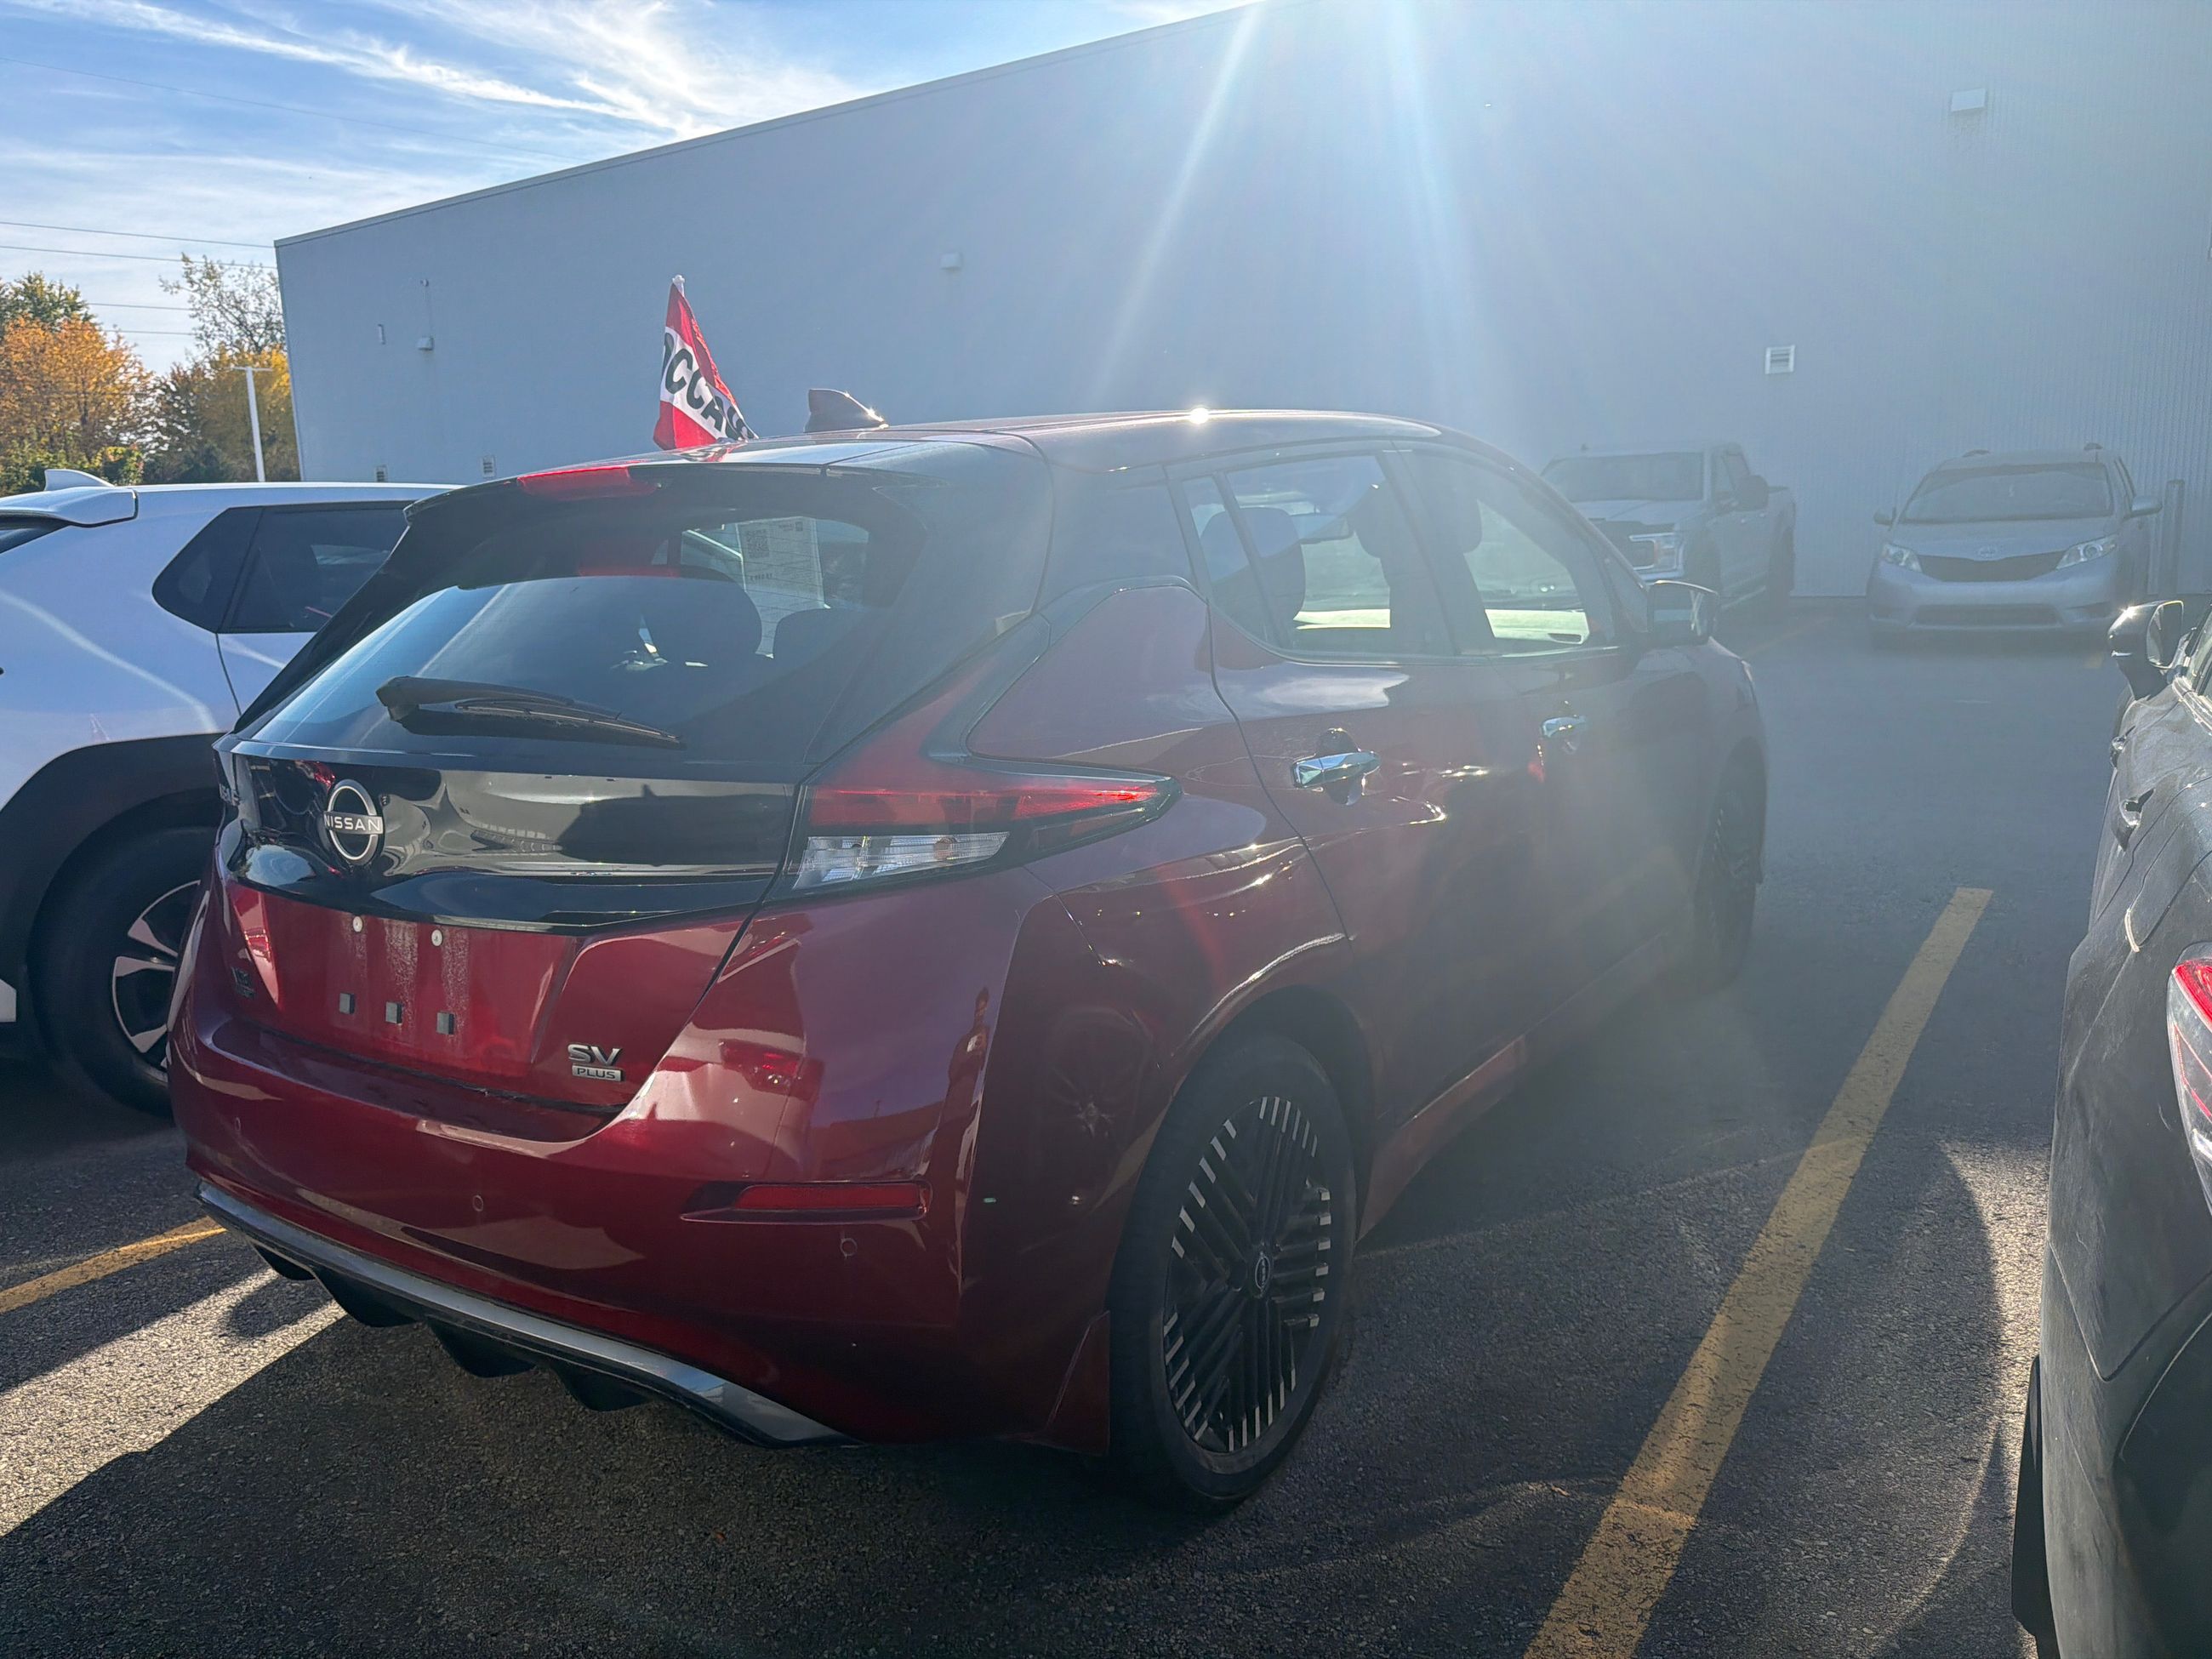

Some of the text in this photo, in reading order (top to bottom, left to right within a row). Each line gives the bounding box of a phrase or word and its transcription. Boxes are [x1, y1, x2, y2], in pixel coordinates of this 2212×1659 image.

[323, 813, 380, 831] NISSAN
[567, 1043, 621, 1067] SV
[577, 1067, 616, 1080] PLUS
